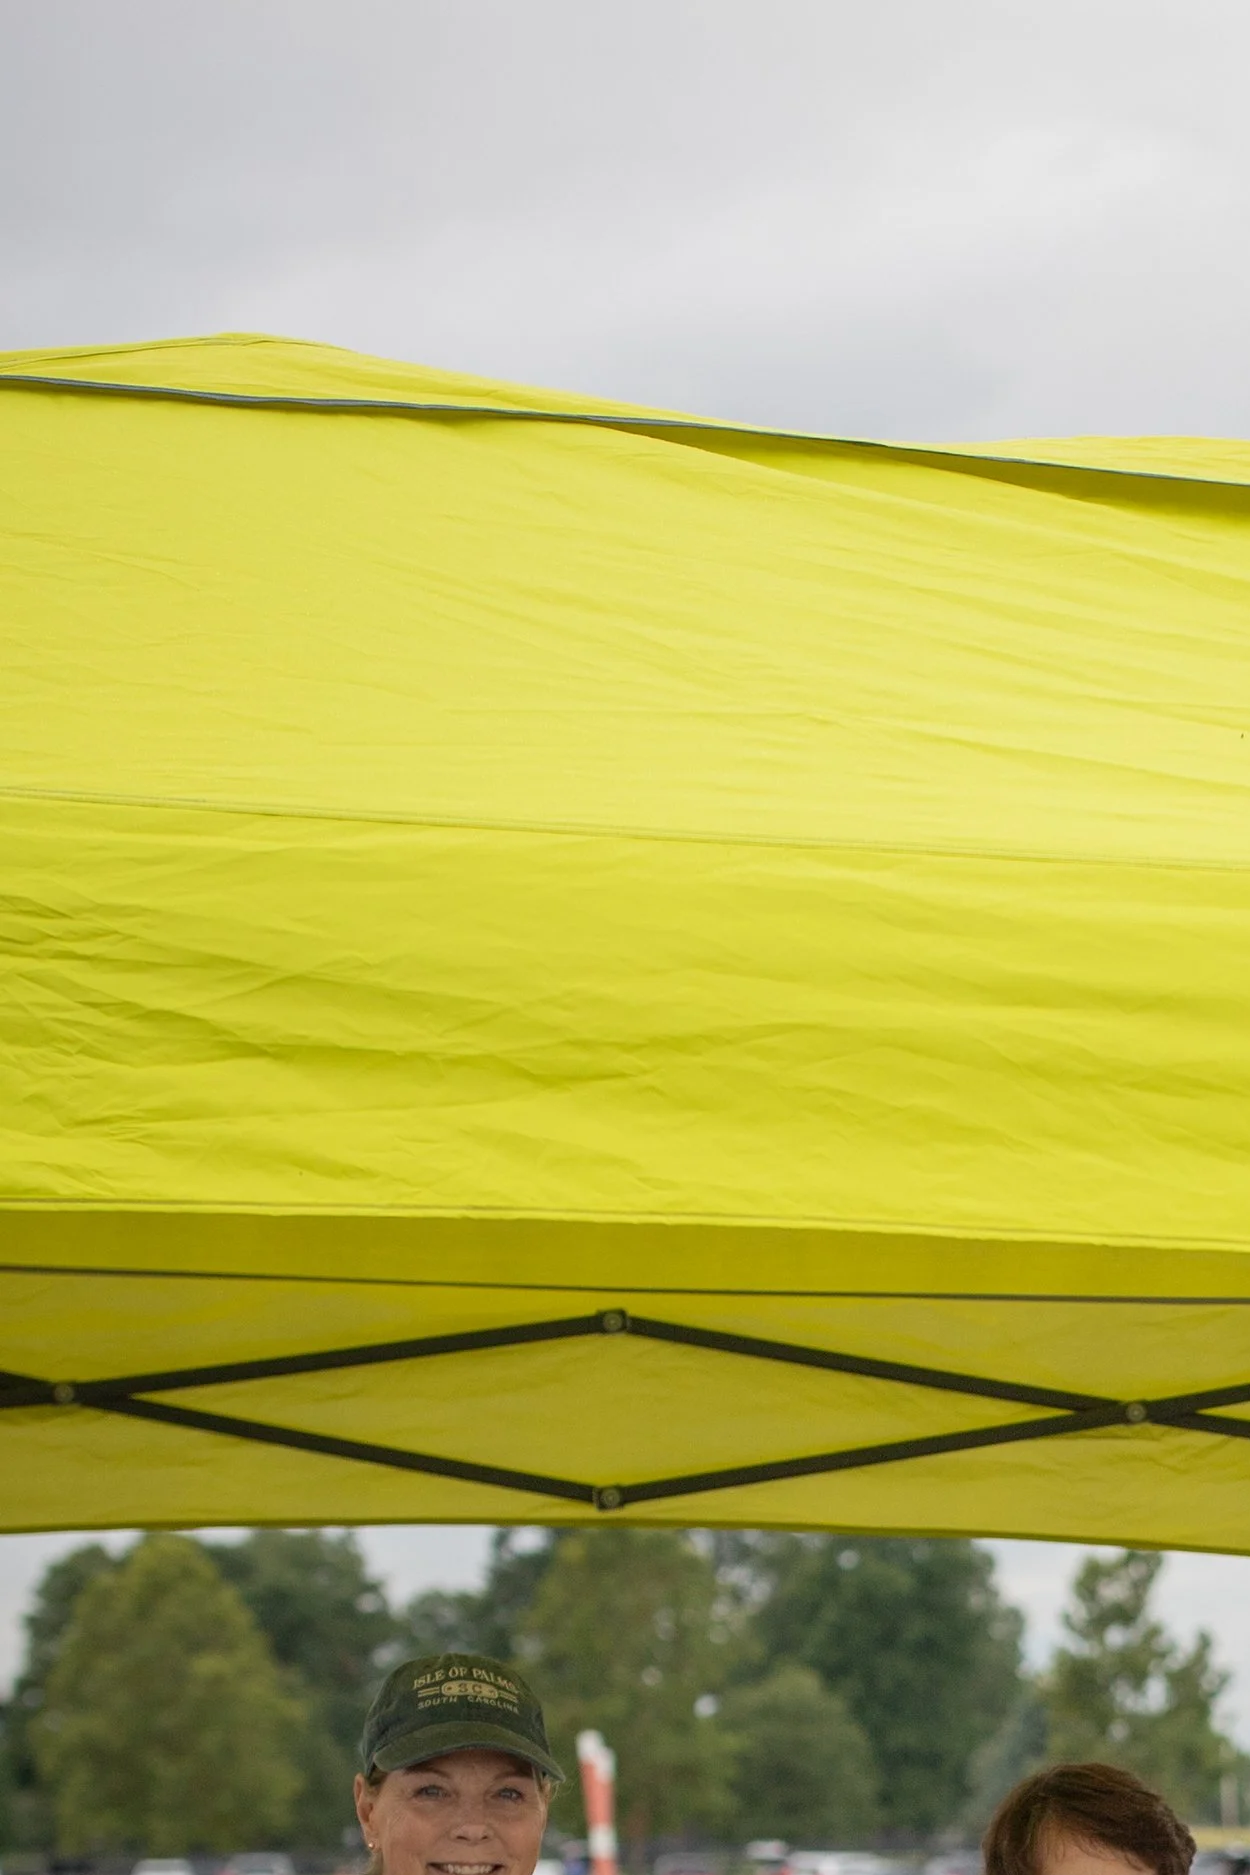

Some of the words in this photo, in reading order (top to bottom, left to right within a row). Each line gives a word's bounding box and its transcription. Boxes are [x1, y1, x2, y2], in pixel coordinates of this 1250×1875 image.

[412, 1669, 446, 1691] ISLE
[448, 1666, 468, 1679] OF
[472, 1668, 519, 1694] PALMS
[459, 1683, 483, 1694] SC
[417, 1696, 459, 1710] SOUTH
[467, 1696, 520, 1715] CAROLINA
